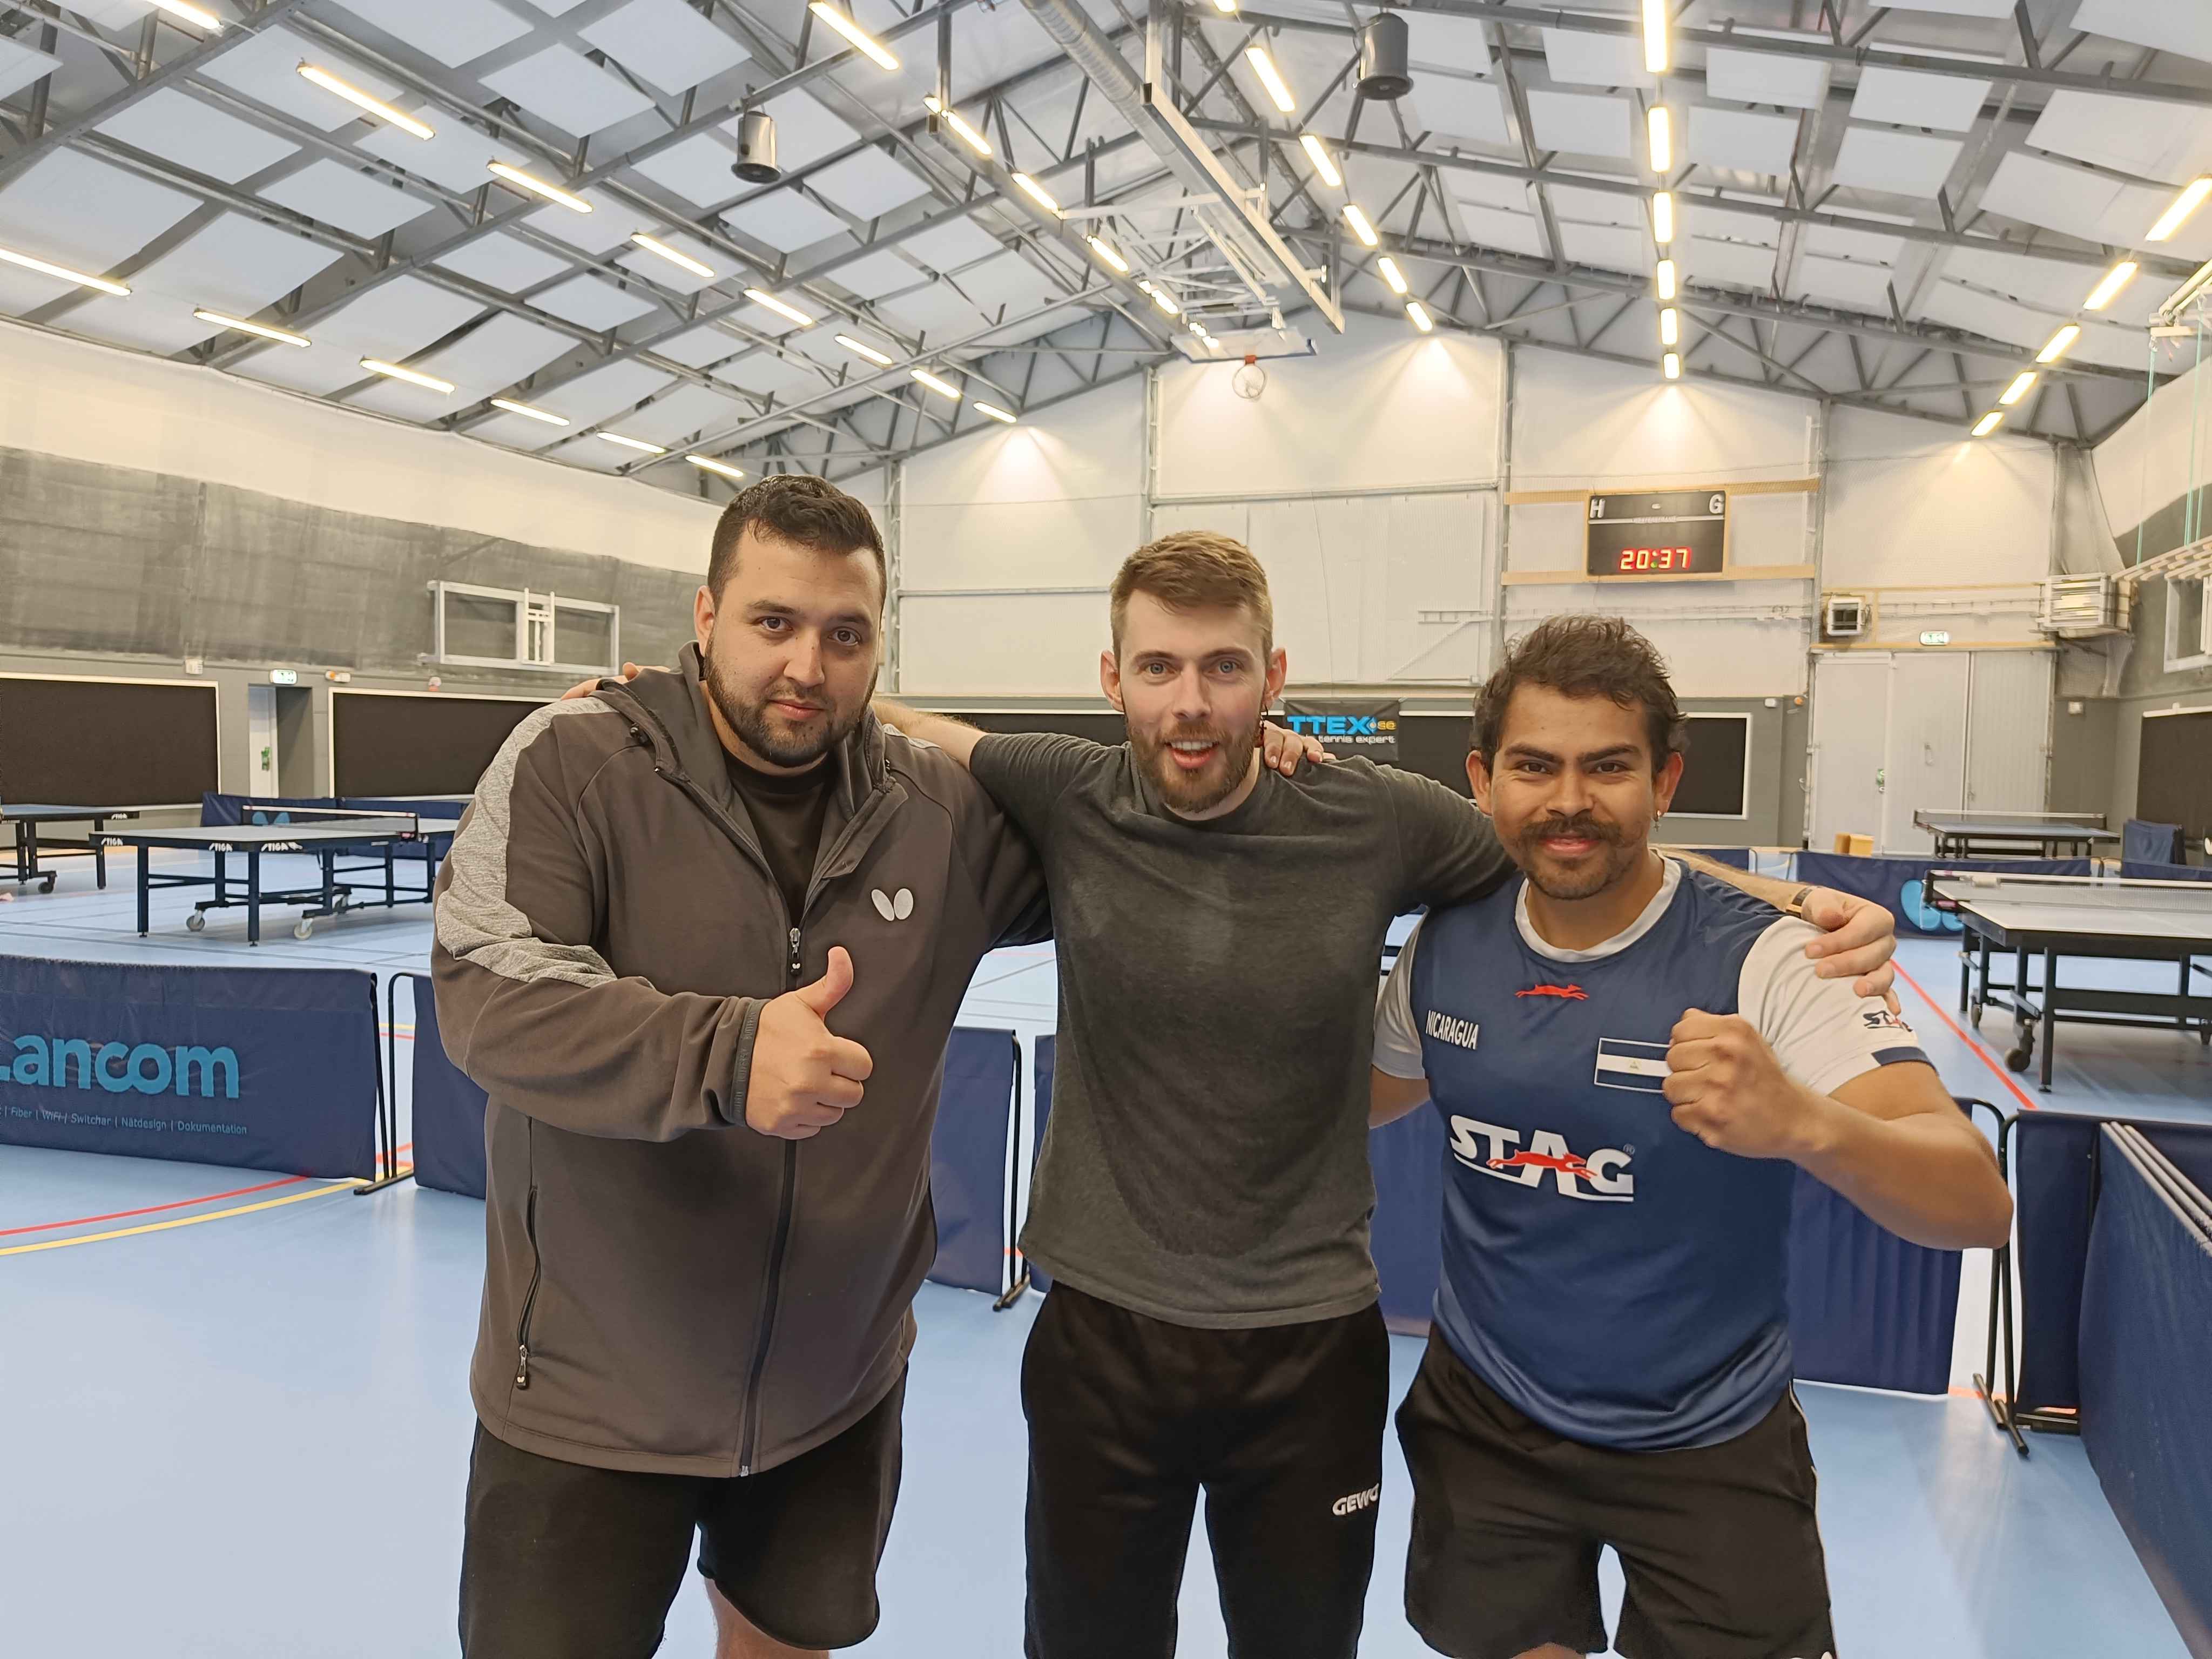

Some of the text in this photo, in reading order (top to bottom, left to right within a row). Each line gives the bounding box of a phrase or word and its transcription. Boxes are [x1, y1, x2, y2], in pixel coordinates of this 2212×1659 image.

[1590, 498, 1606, 518] H
[1709, 494, 1724, 514] G
[1620, 547, 1690, 570] 20:37
[1318, 734, 1353, 744] tennis
[1355, 734, 1396, 745] expert
[1425, 1010, 1479, 1050] NICARAGUA
[11, 1107, 32, 1118] Fiber
[71, 1112, 112, 1127] Switchar
[122, 1117, 167, 1131] Nätdesign
[177, 1120, 247, 1135] Dokumentation
